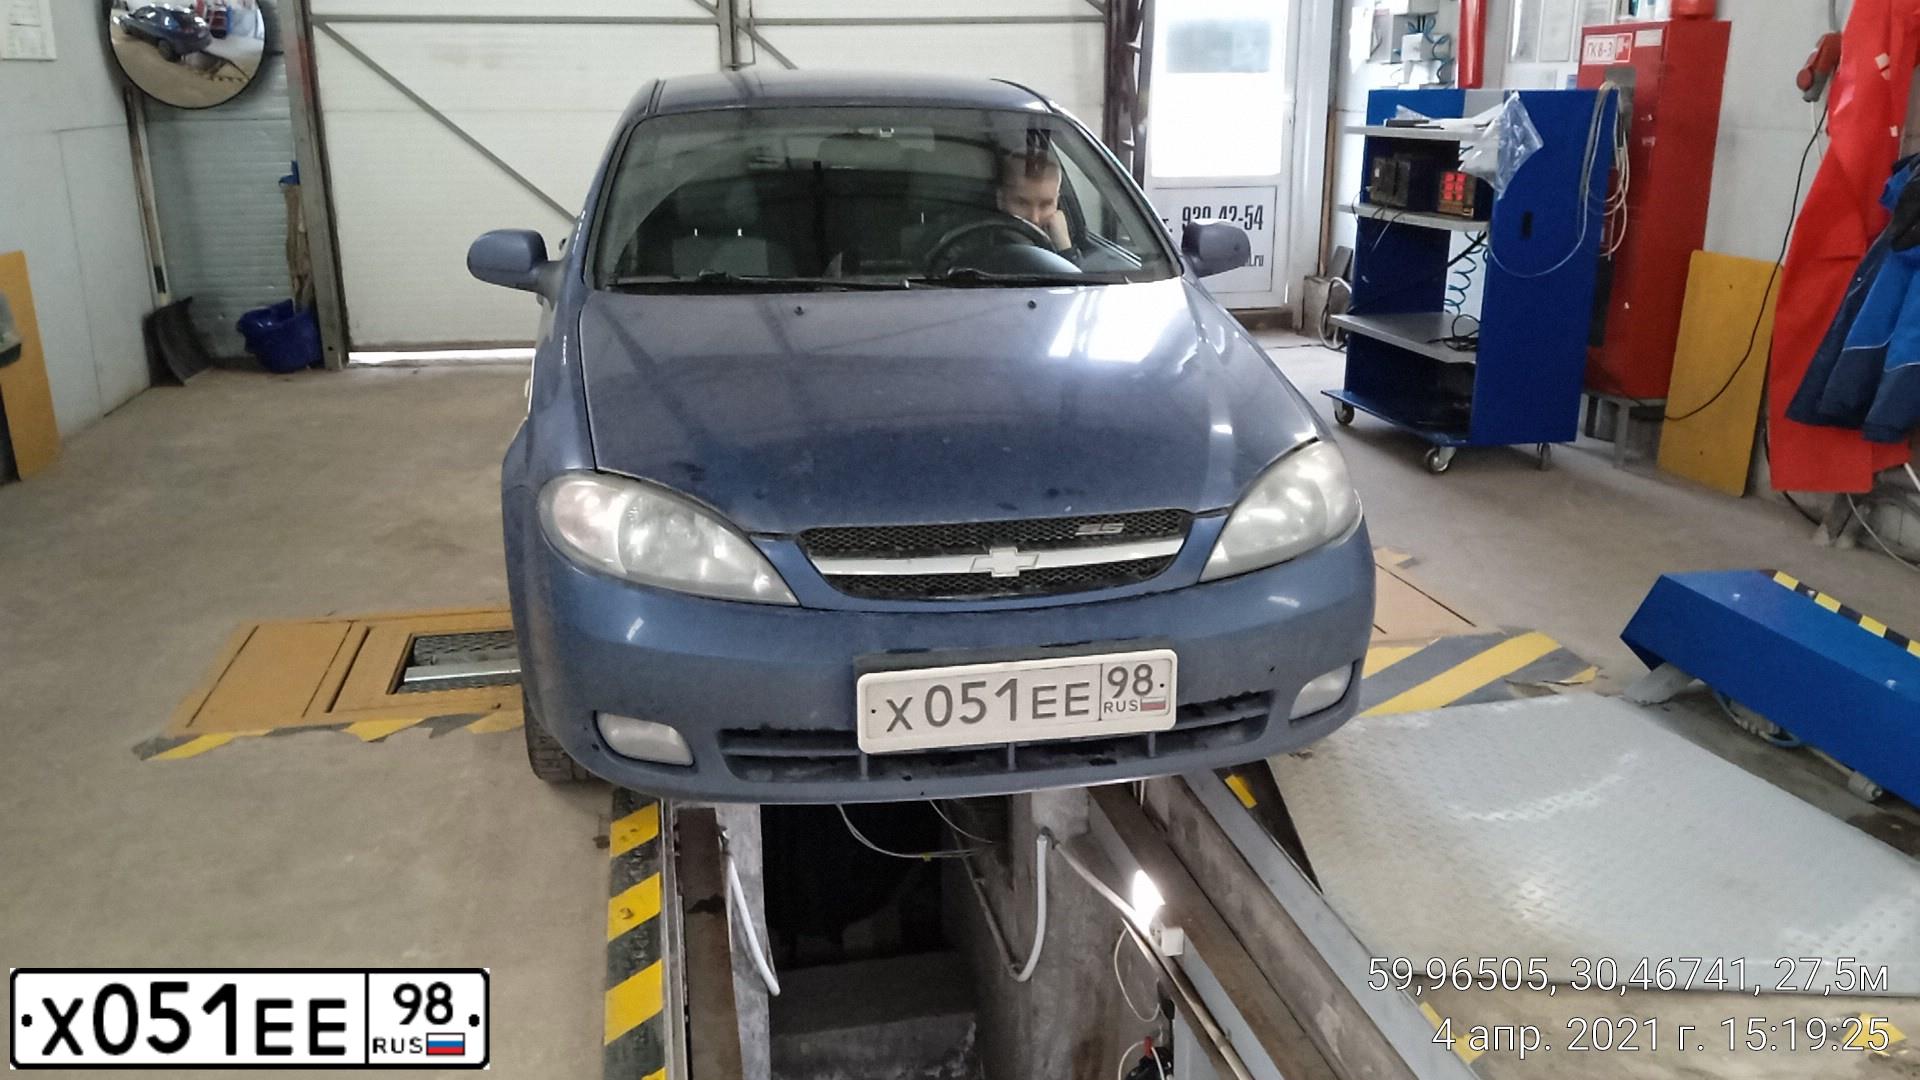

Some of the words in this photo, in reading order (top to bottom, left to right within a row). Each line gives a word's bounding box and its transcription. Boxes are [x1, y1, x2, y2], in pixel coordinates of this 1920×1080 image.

[886, 678, 1090, 732] Х051ЕЕ
[1107, 663, 1153, 699] 98
[1103, 699, 1138, 714] RUS
